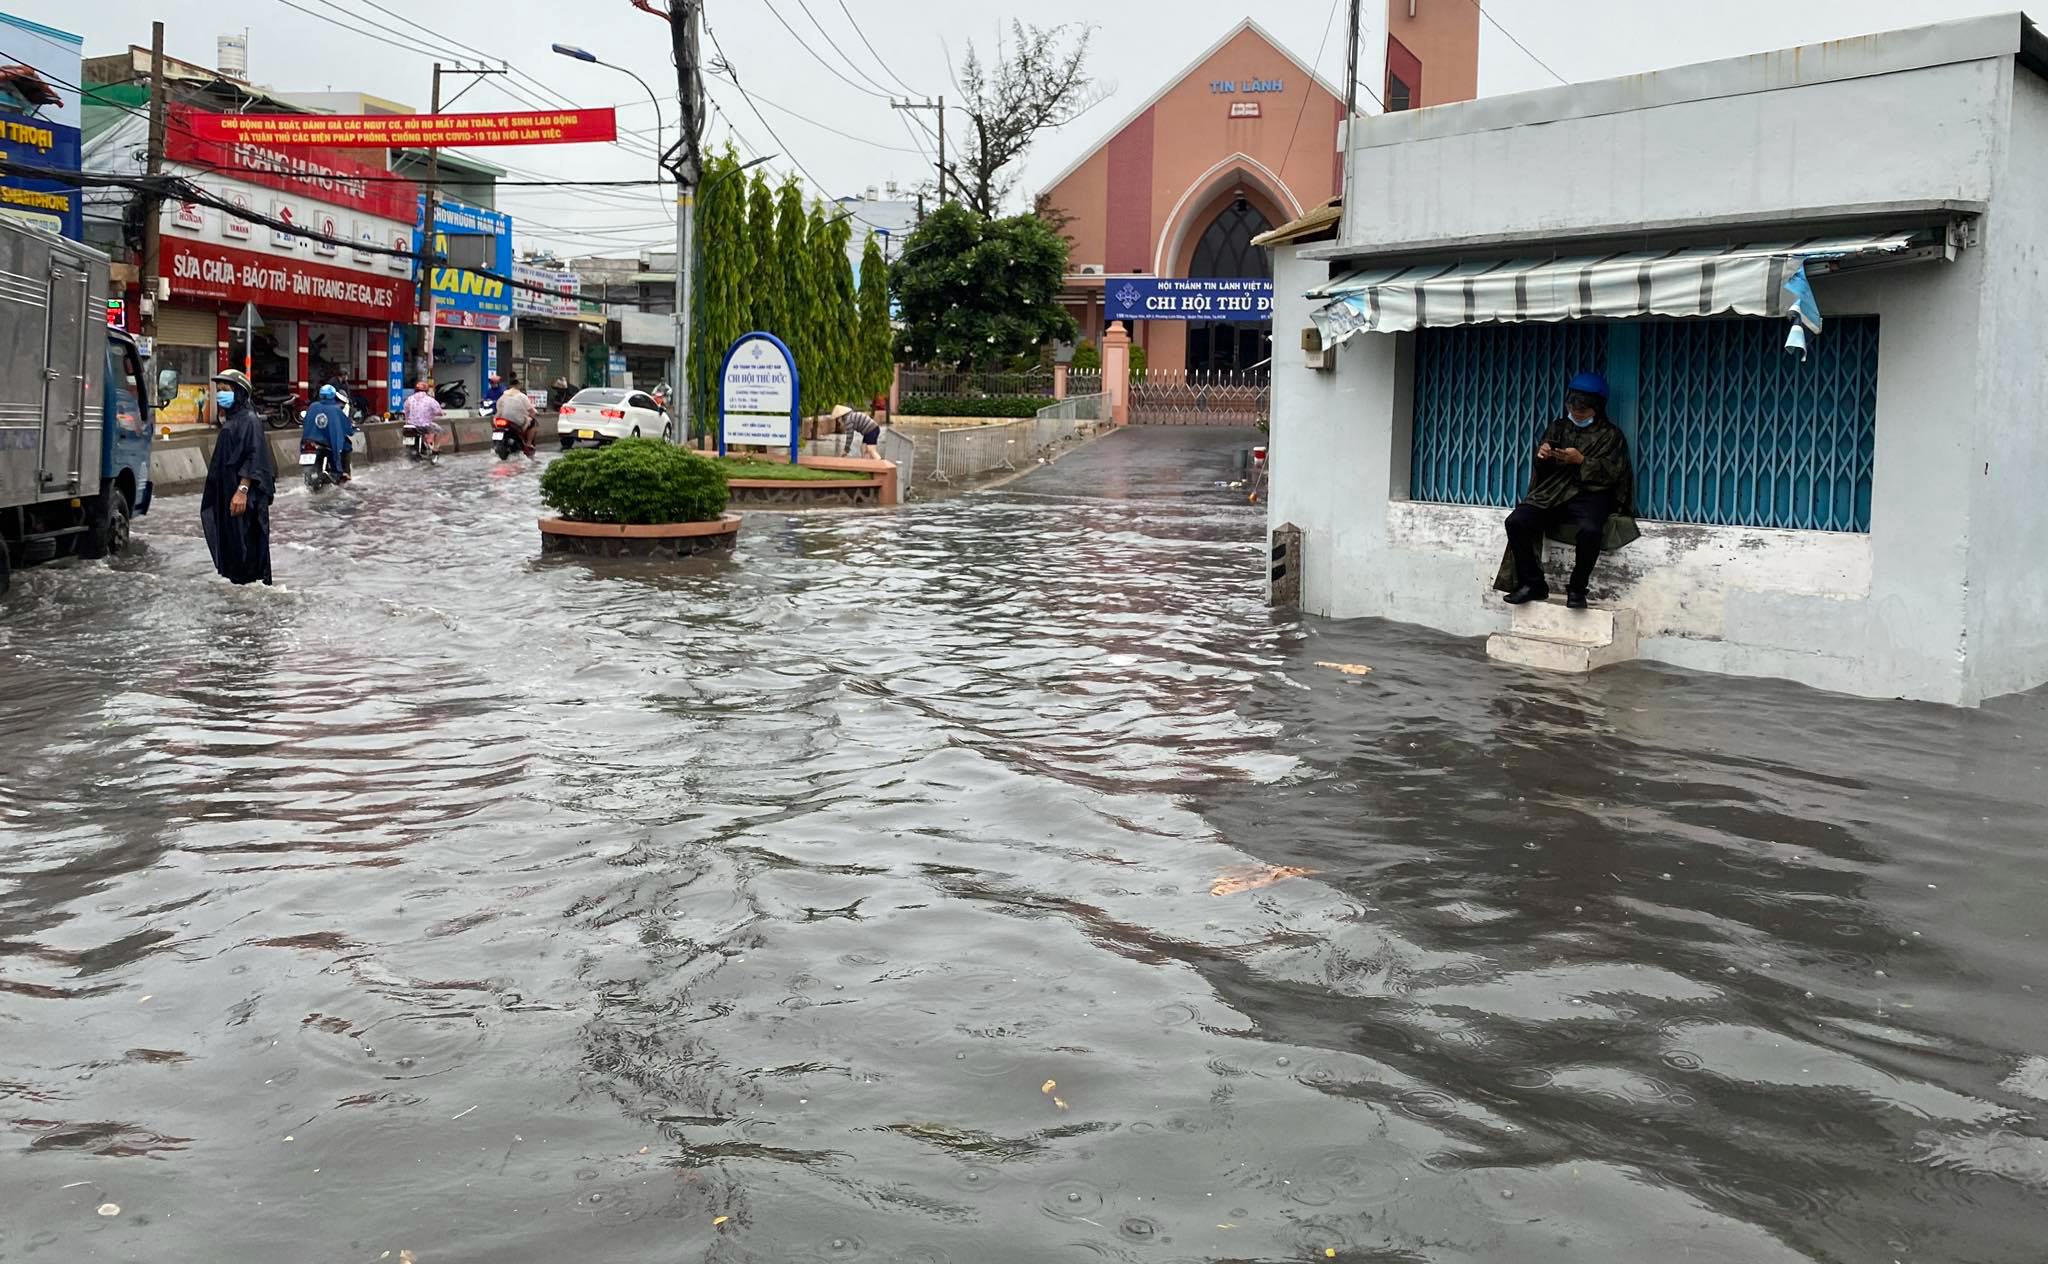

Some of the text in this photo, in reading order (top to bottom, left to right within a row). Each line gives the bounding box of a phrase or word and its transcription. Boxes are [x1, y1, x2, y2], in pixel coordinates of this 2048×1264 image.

[1210, 76, 1283, 93] TIN LÀNH
[221, 118, 238, 129] CHỦ
[240, 119, 262, 131] ĐỘNG
[264, 118, 277, 129] RÀ
[303, 118, 326, 129] ĐÁNH
[328, 118, 343, 129] GIÁ
[344, 118, 361, 129] CÁC
[364, 120, 386, 129] NGUY
[405, 118, 419, 129] RỦI
[421, 119, 433, 129] RO
[435, 117, 454, 128] MẤT
[456, 118, 469, 128] AN
[498, 117, 509, 129] VỆ
[511, 116, 533, 126] SINH
[535, 116, 551, 125] LAO
[553, 114, 578, 127] ĐỘNG
[7, 122, 53, 154] THOẠI
[239, 131, 250, 142] VÀ
[251, 131, 273, 142] TUÂN
[275, 131, 291, 142] THỦ
[292, 131, 310, 142] CÁC
[311, 132, 331, 144] BIỆN
[333, 131, 355, 142] PHÁP
[391, 131, 421, 142] CHỐNG
[423, 133, 444, 144] DỊCH
[445, 132, 485, 141] COVID-19
[487, 131, 501, 143] TẠI
[503, 131, 519, 140] NƠI
[521, 130, 540, 140] LÀM
[542, 129, 562, 140] VIỆC
[179, 213, 203, 224] HONDA
[230, 224, 249, 234] YAMAHA
[174, 249, 201, 280] SỬA
[203, 256, 235, 285] CHỮA
[243, 261, 267, 290] BẢO
[267, 267, 287, 292] TRÌ
[312, 277, 345, 301] TRANG
[345, 283, 358, 302] XE
[374, 287, 385, 307] XE
[1158, 280, 1172, 291] HỘI
[1174, 279, 1202, 290] THÁNH
[1204, 282, 1217, 290] TIN
[1243, 280, 1261, 292] VIỆT
[1146, 297, 1177, 310] CHI
[1181, 293, 1212, 313] HỘI
[1217, 292, 1252, 310] THỦ
[728, 372, 787, 384] CHI HỘI THỦ ĐỨC
